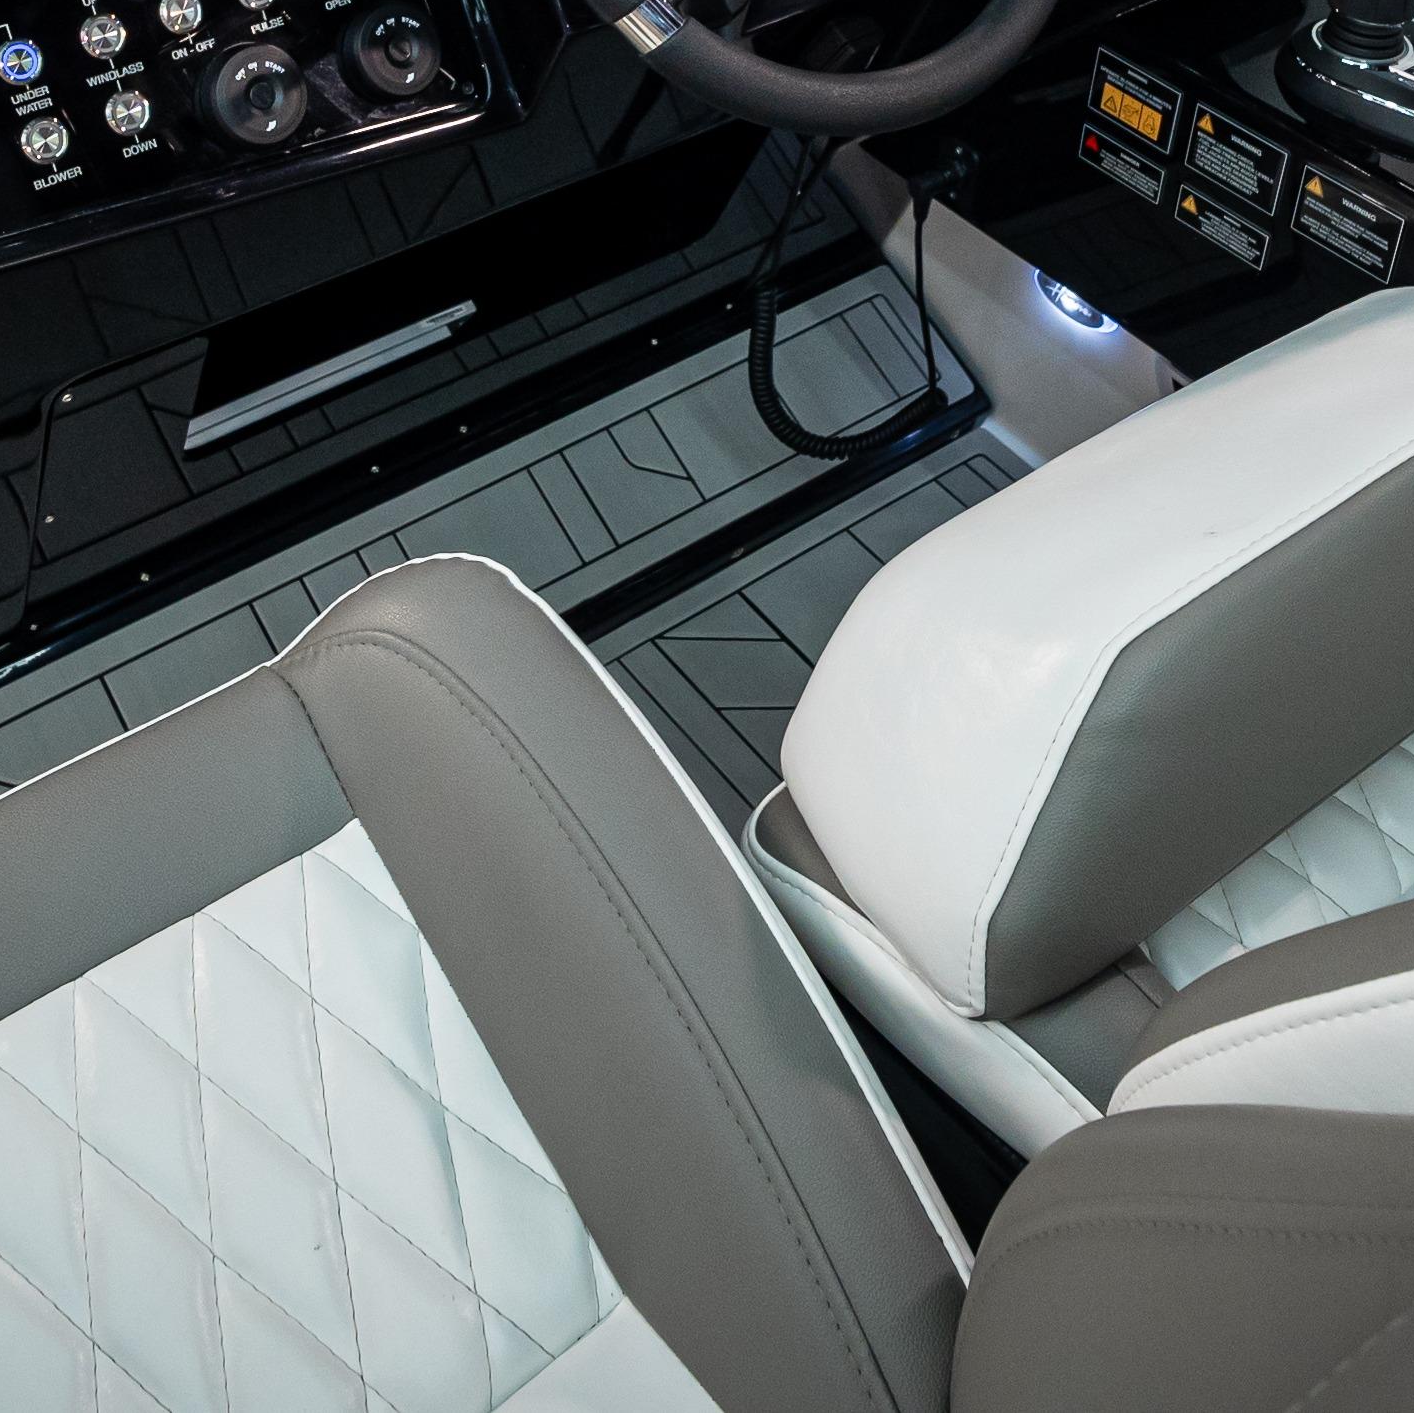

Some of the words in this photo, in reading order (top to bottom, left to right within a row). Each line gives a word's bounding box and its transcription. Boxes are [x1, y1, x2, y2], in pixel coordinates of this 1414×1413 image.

[250, 16, 285, 35] PULSE
[86, 61, 145, 87] WINDLASS
[10, 85, 50, 105] UNDER
[15, 97, 54, 117] WATER
[122, 138, 158, 159] DOWN
[1231, 133, 1262, 157] WARNING
[33, 166, 84, 191] BLOWER
[1341, 197, 1377, 222] WARNING
